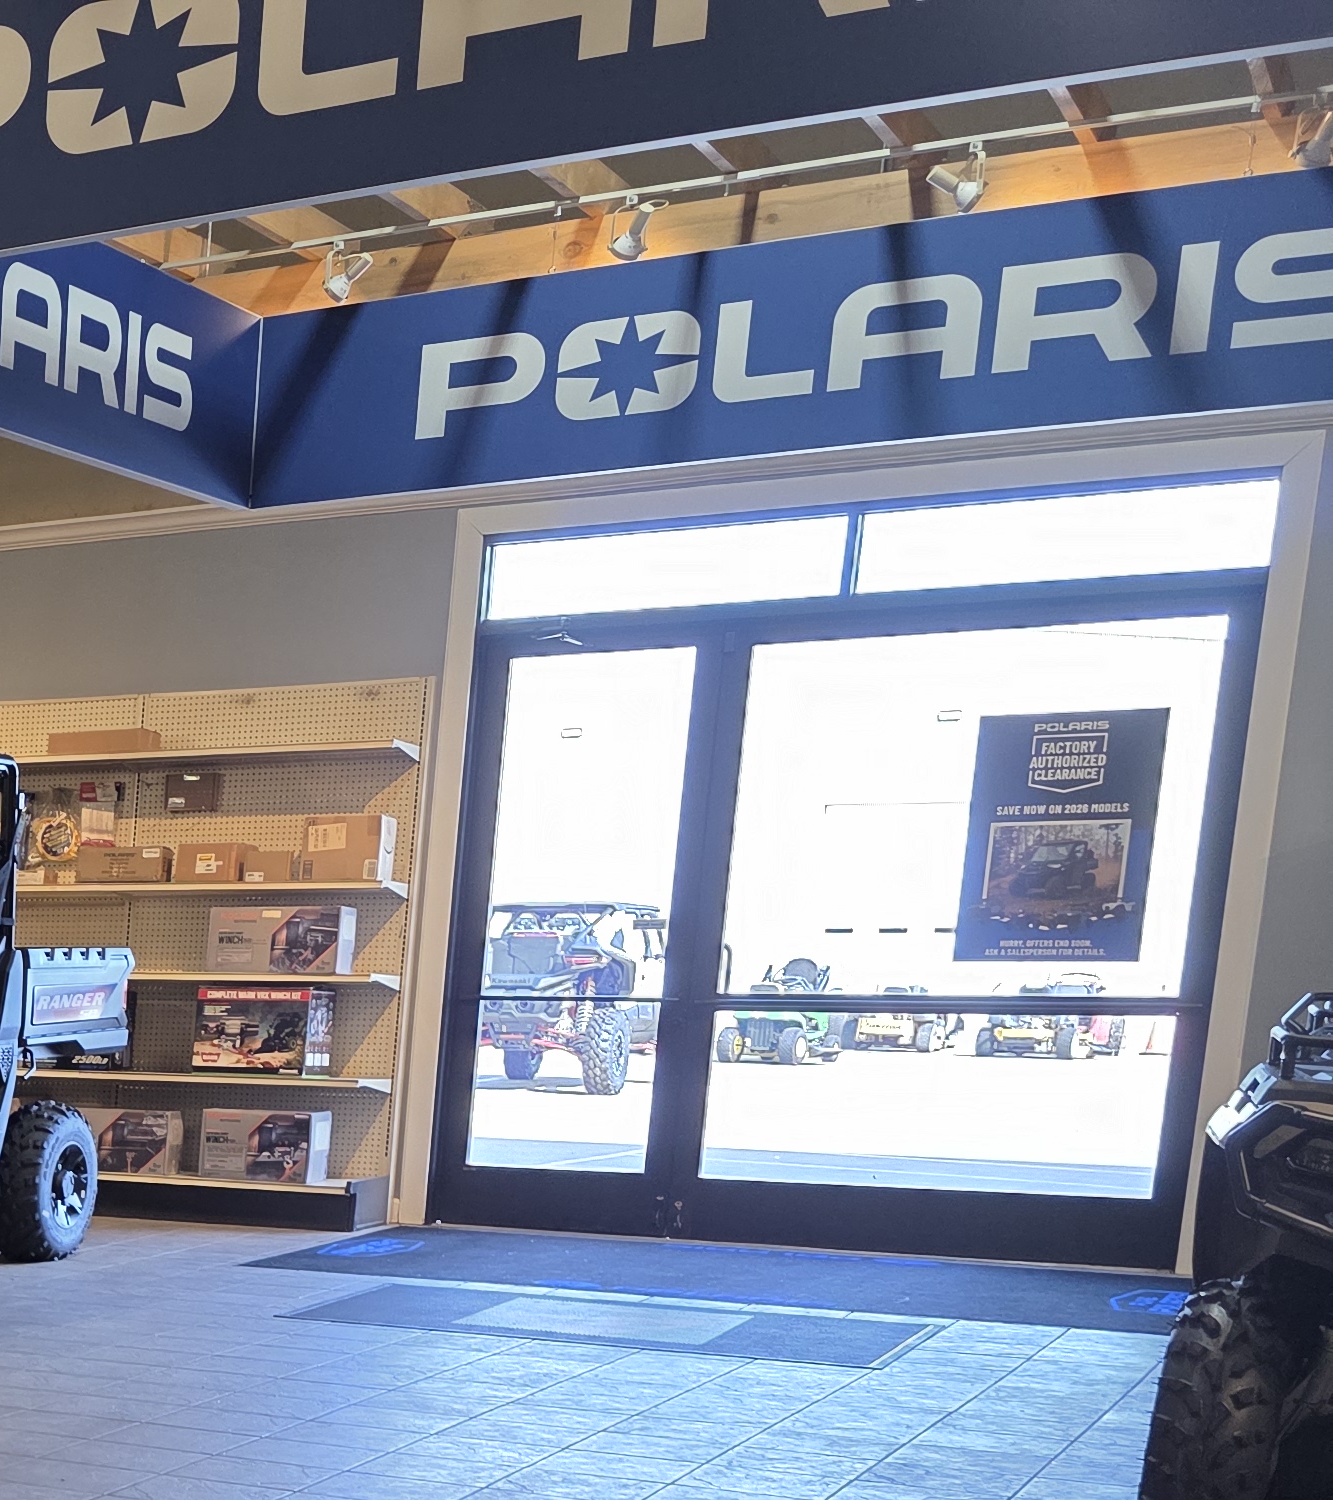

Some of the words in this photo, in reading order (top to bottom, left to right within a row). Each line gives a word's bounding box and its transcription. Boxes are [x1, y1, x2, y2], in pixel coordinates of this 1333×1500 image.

[415, 228, 1333, 441] POLARIS
[1034, 721, 1110, 732] POLARIS
[1041, 740, 1097, 754] FACTORY
[1029, 754, 1107, 769] AUTHORIZED
[1034, 767, 1098, 781] CLEARANCE
[996, 805, 1021, 816] SAVE
[1023, 805, 1047, 815] NOW
[1048, 804, 1062, 815] ON
[1064, 804, 1089, 814] 2026
[1091, 803, 1130, 813] MODELS
[218, 935, 244, 944] WINCH
[36, 992, 106, 1010] RANGER
